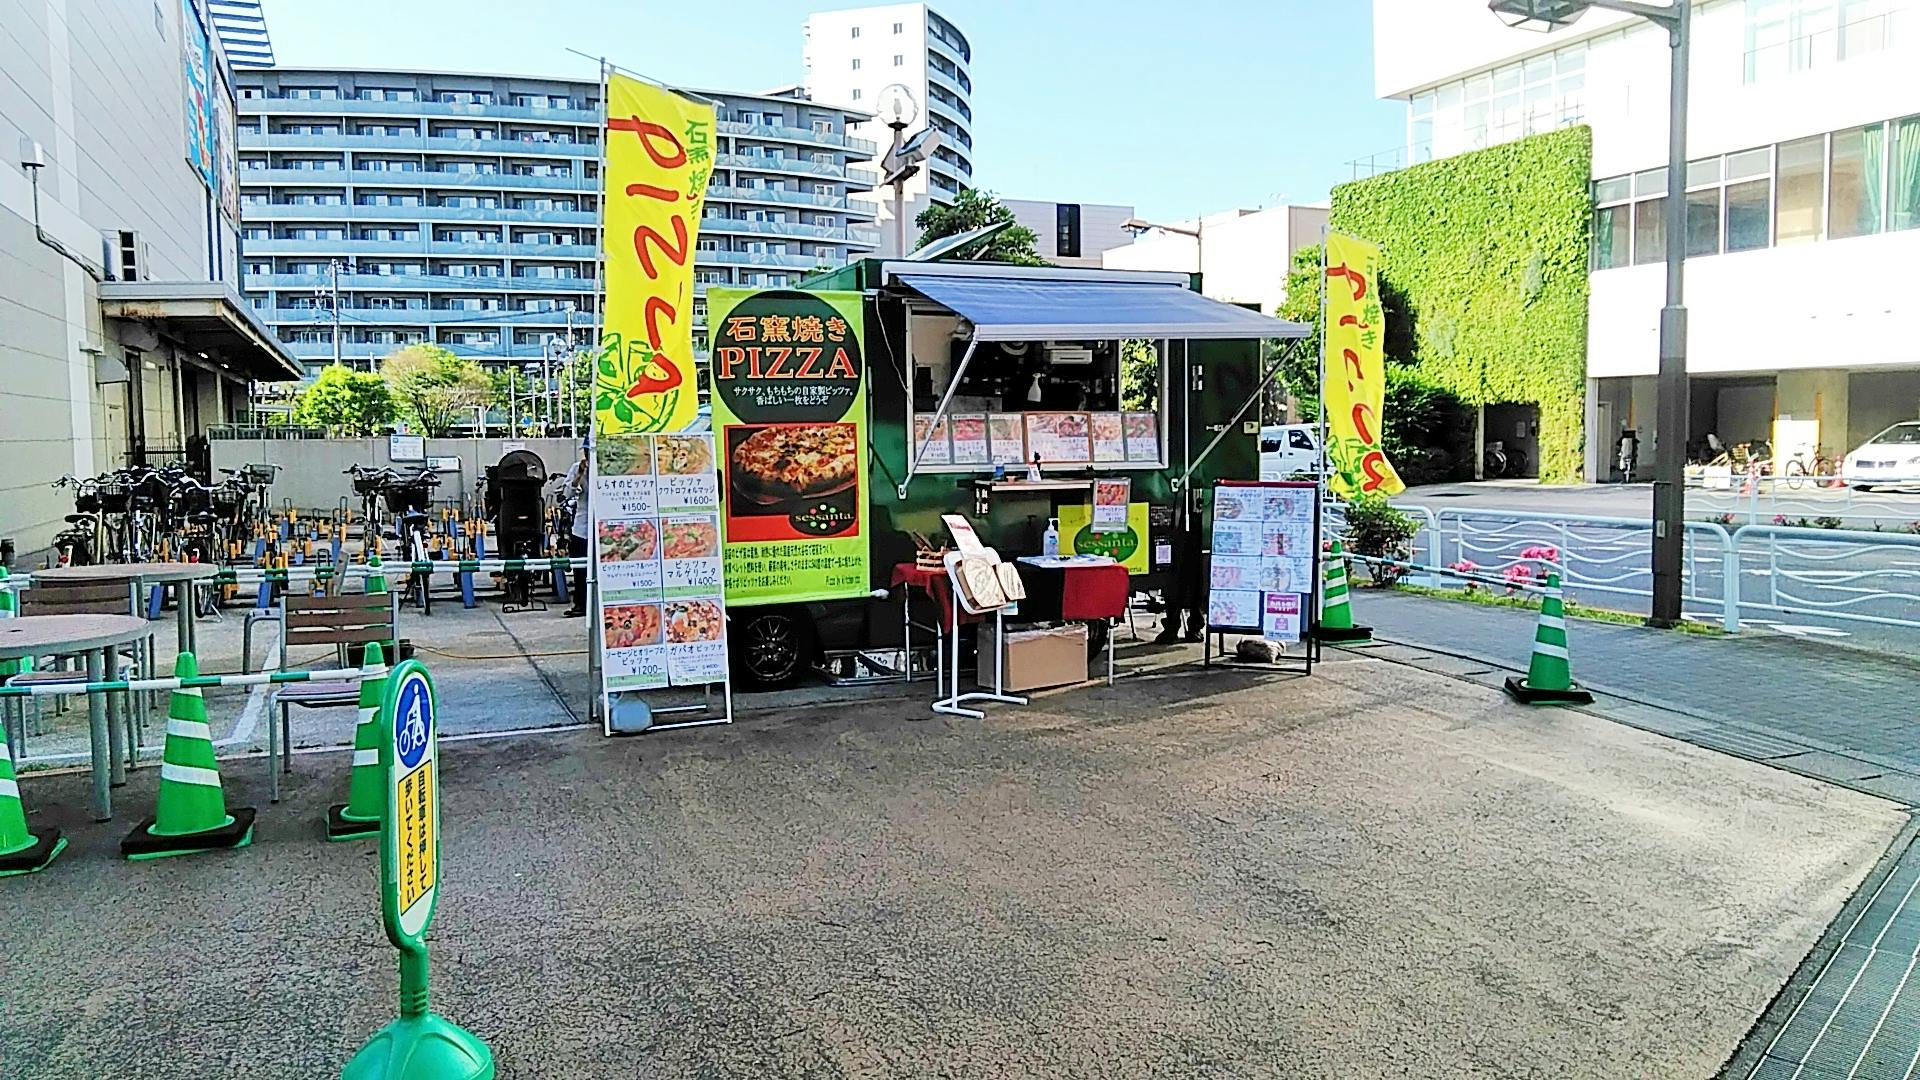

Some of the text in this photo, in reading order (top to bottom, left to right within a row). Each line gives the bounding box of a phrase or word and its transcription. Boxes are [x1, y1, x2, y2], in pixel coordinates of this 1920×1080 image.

[607, 114, 688, 399] PIZZA
[726, 315, 848, 343] 石窯焼き
[716, 346, 859, 379] PIZZA
[756, 395, 830, 406] 香ばしい一枚をどうぞ
[596, 479, 655, 490] しらすのピッツァ
[670, 477, 702, 487] ピッツァ
[658, 484, 715, 495] クワトロフォルマッジ
[675, 559, 707, 569] ピッツァ
[667, 567, 716, 578] マルゲリータ
[605, 647, 665, 659] ソーセージとオリーブの
[670, 644, 723, 656] ガパオピッツァ
[622, 657, 649, 666] ピッツァ
[418, 769, 427, 891] 自転車は押して
[405, 778, 414, 904] 歩いてください
